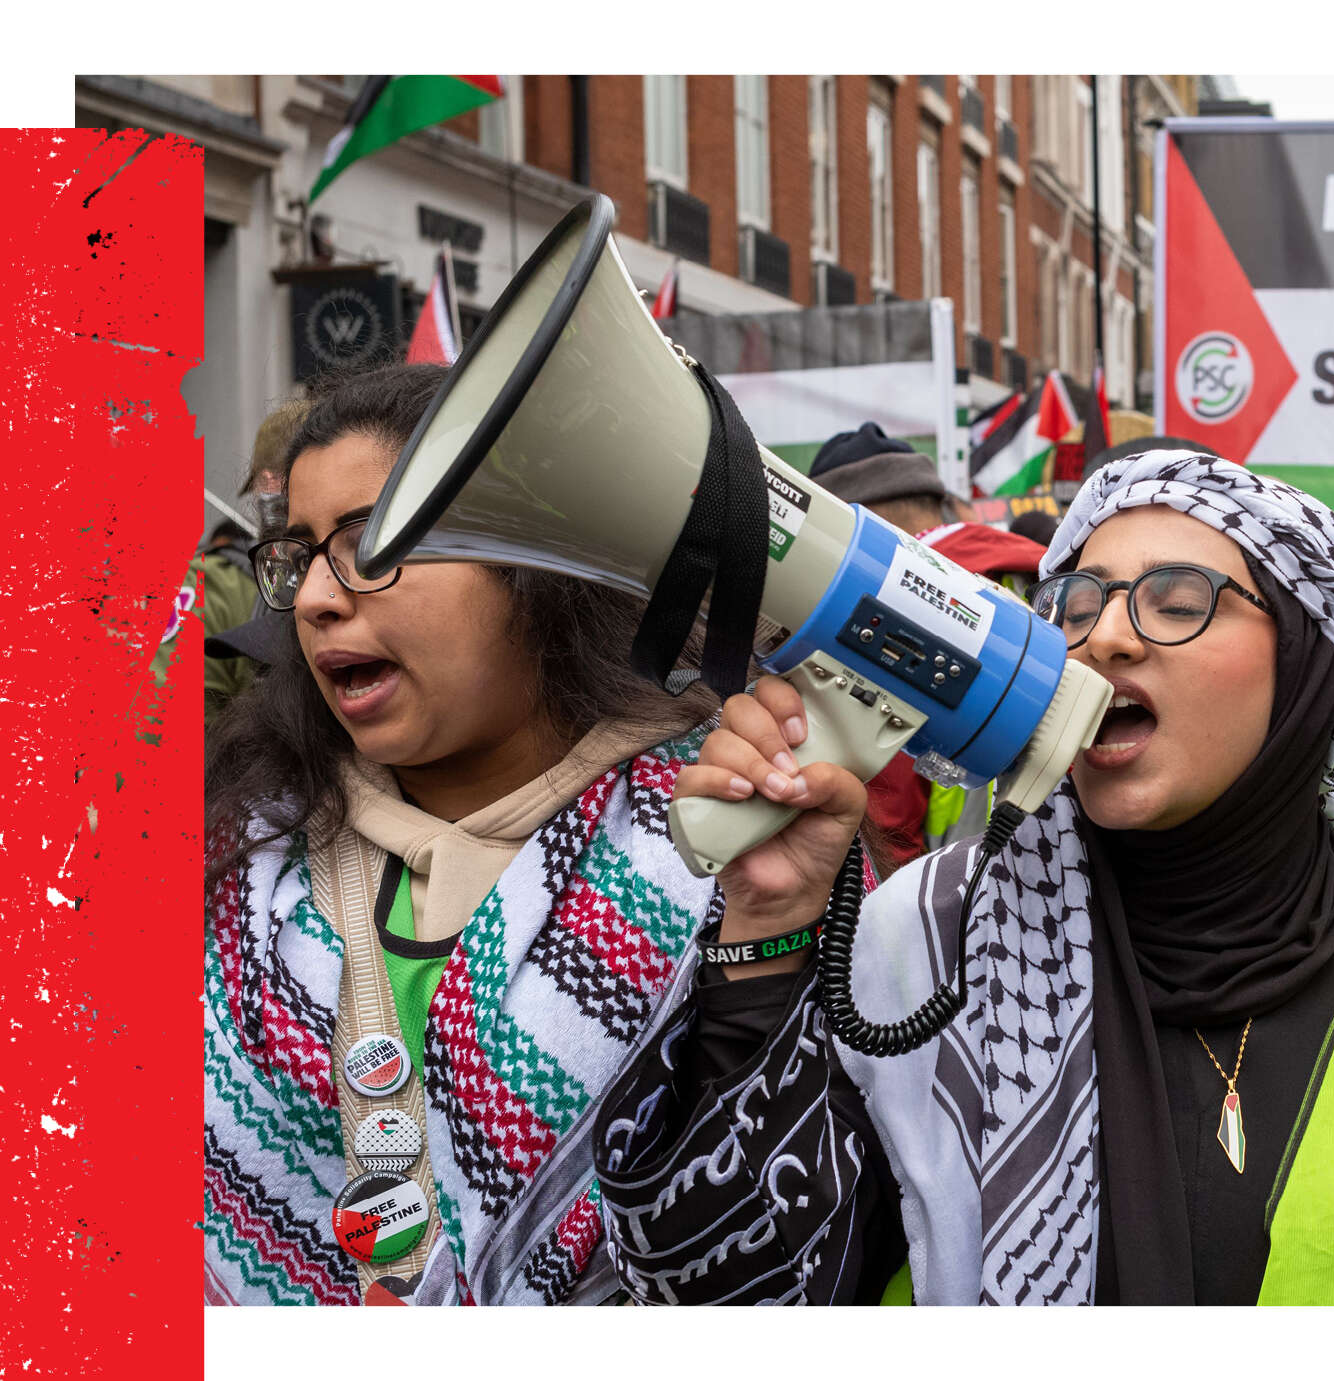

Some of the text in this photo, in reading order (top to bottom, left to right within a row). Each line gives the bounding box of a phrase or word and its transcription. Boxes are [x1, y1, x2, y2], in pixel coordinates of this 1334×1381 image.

[1193, 365, 1236, 392] PSC
[903, 569, 947, 602] FREE
[900, 578, 978, 632] PALESTINE
[706, 930, 812, 963] SAVE GAZA
[347, 1040, 396, 1074] PALESTINE
[352, 1047, 400, 1080] WILL BE FREE
[344, 1174, 372, 1197] Solidarity
[373, 1172, 406, 1182] Campaign
[345, 1202, 423, 1242] PALESTINE
[360, 1198, 397, 1221] FREE
